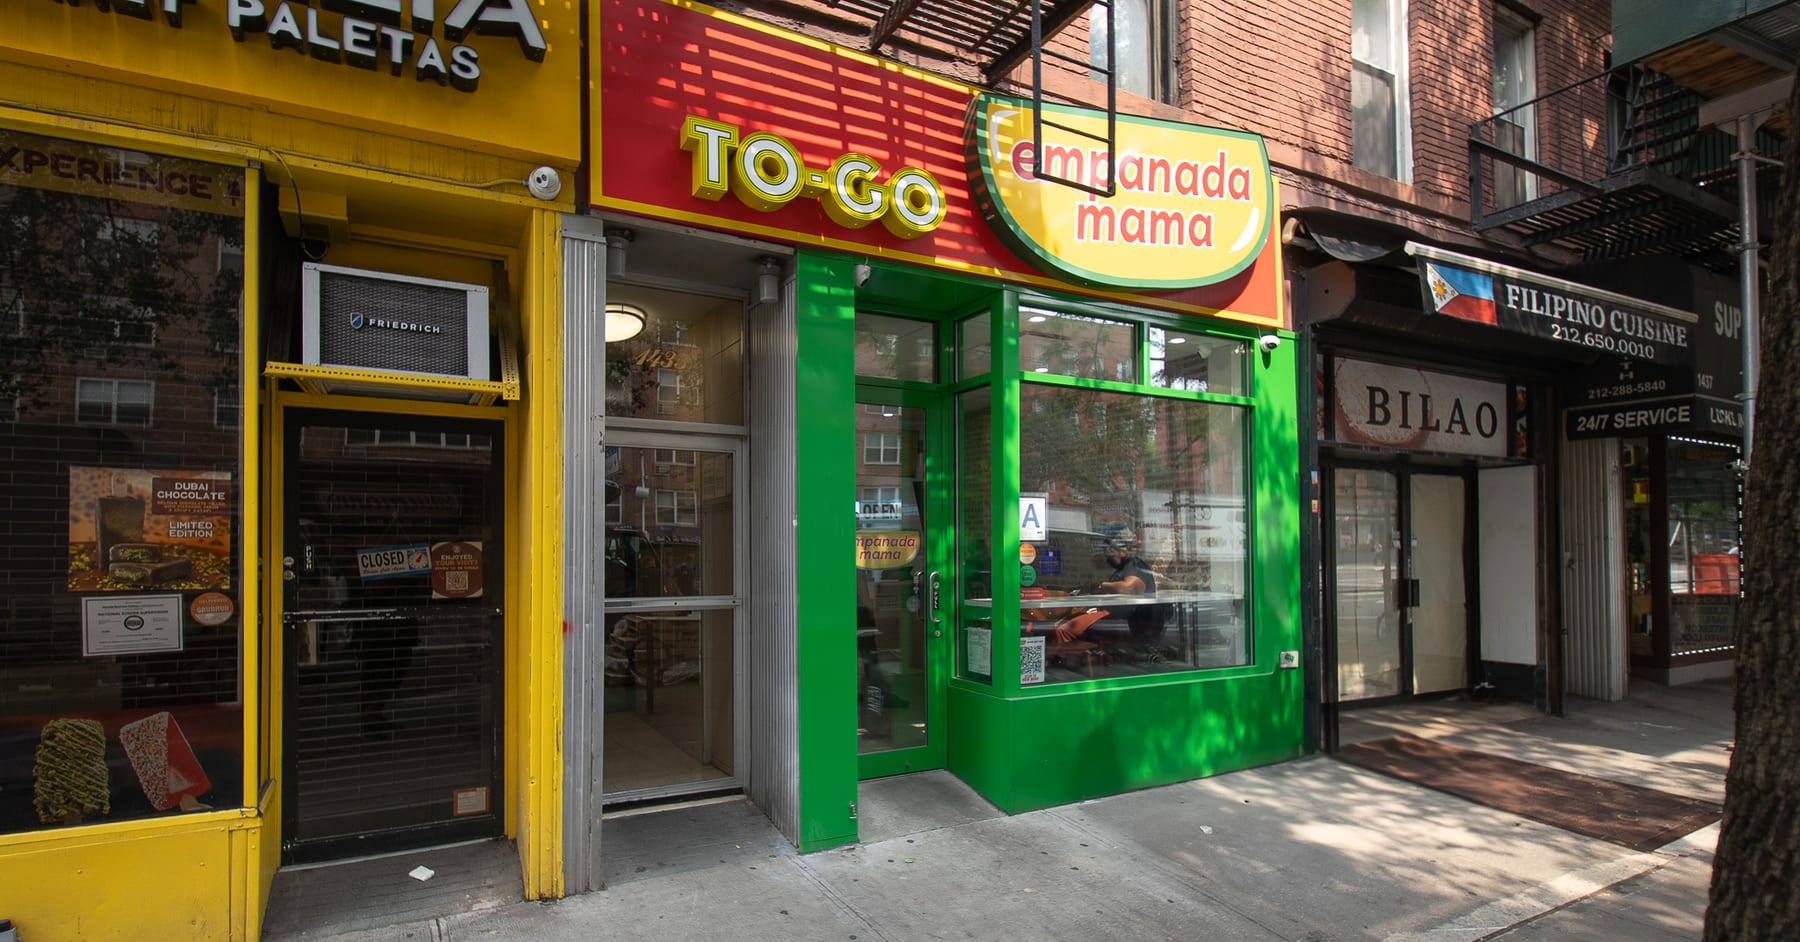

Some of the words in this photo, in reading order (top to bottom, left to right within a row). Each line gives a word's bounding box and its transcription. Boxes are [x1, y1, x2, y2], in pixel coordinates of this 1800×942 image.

[227, 0, 481, 83] PALETAS
[0, 146, 213, 200] XPERIENCE
[687, 117, 945, 233] TO-GO
[1011, 140, 1254, 203] empanada
[1076, 199, 1215, 249] mama
[368, 318, 441, 334] FRIEDRICH
[1505, 283, 1607, 330] FILIPINO
[1609, 310, 1689, 348] CUISINE
[1551, 323, 1655, 360] 212.650.0010
[1588, 380, 1666, 399] 212-288-5840
[1366, 385, 1498, 439] BILAO
[1577, 413, 1609, 432] 24/7
[1613, 406, 1691, 429] SERVICE
[157, 490, 226, 500] CHOCOLATE
[175, 482, 209, 491] DUBAI
[863, 503, 899, 519] OPEN
[1021, 503, 1041, 528] A
[169, 521, 213, 529] LIMITED
[169, 529, 213, 537] EDITION
[856, 535, 915, 550] mpanada
[360, 551, 405, 569] CLOSED
[859, 550, 901, 560] mama
